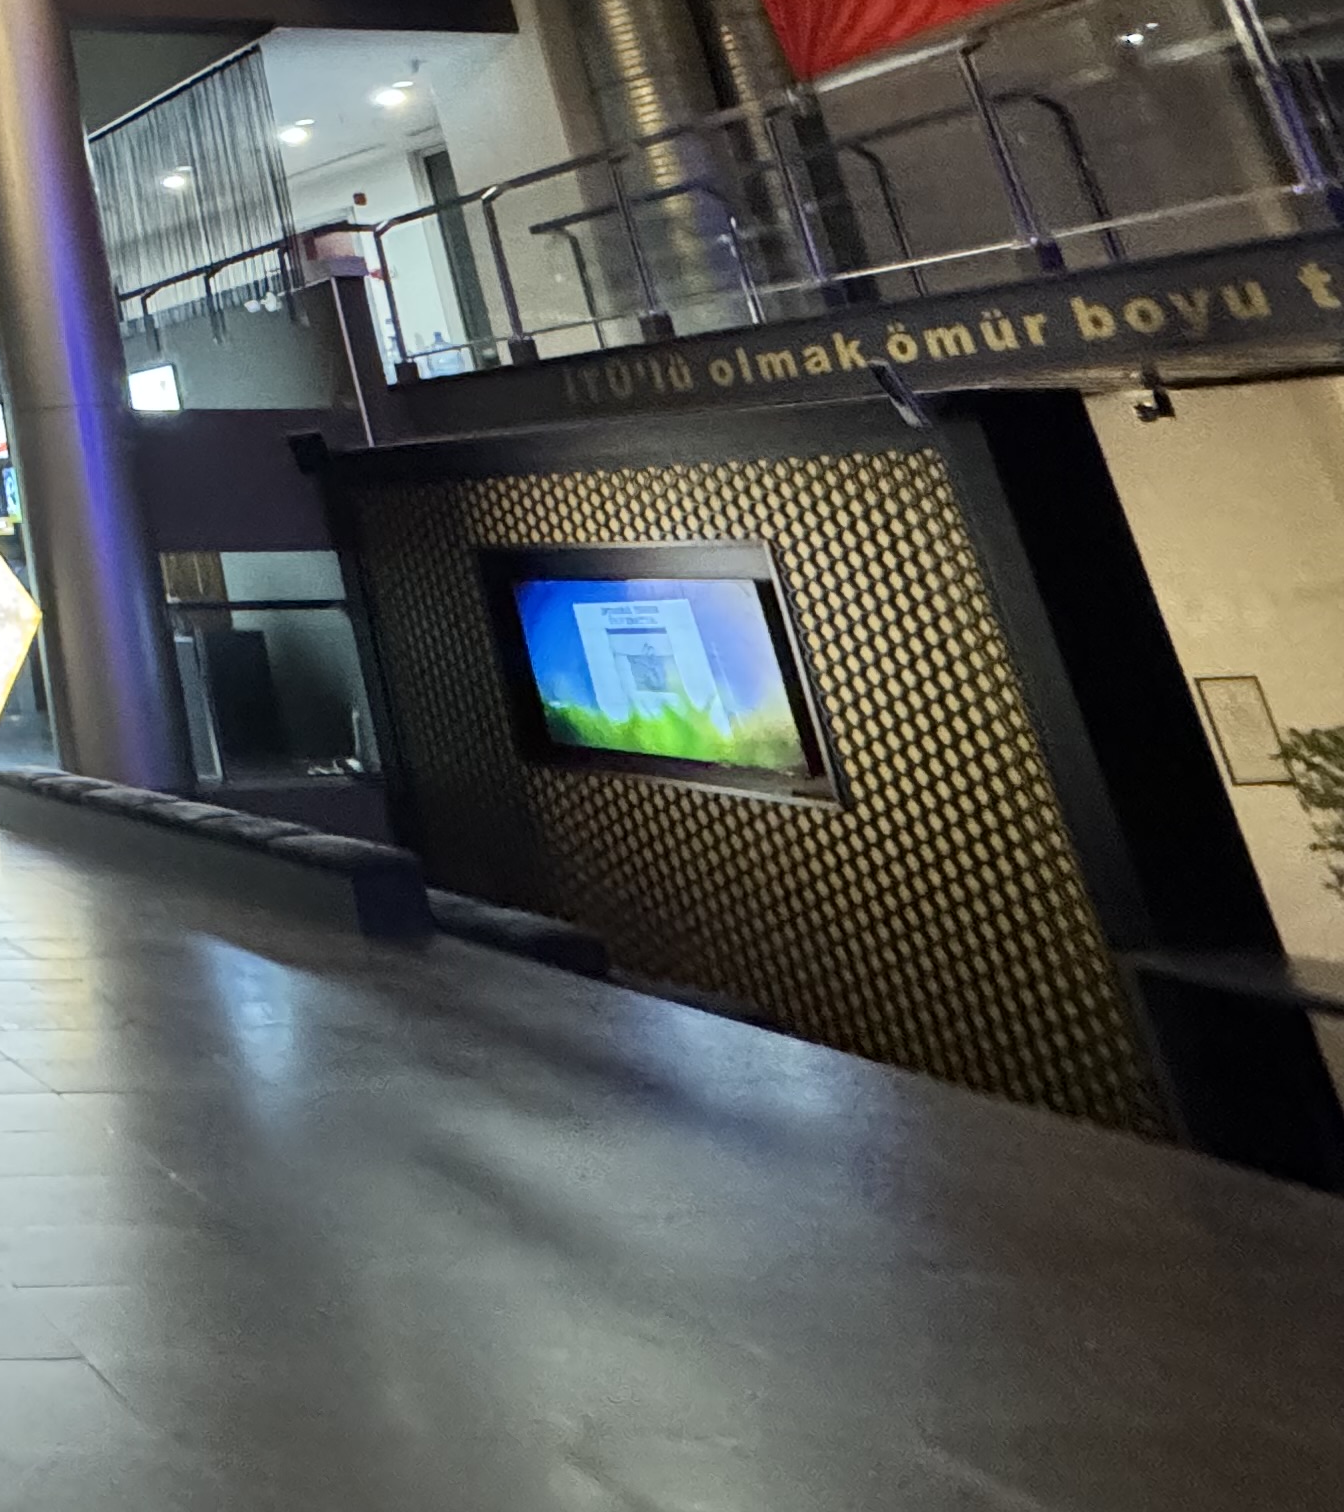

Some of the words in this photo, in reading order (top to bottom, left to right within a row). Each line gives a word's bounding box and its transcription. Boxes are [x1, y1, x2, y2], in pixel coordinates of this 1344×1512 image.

[708, 332, 869, 387] olmak
[886, 308, 1048, 364] ömür
[1070, 281, 1272, 340] boyu
